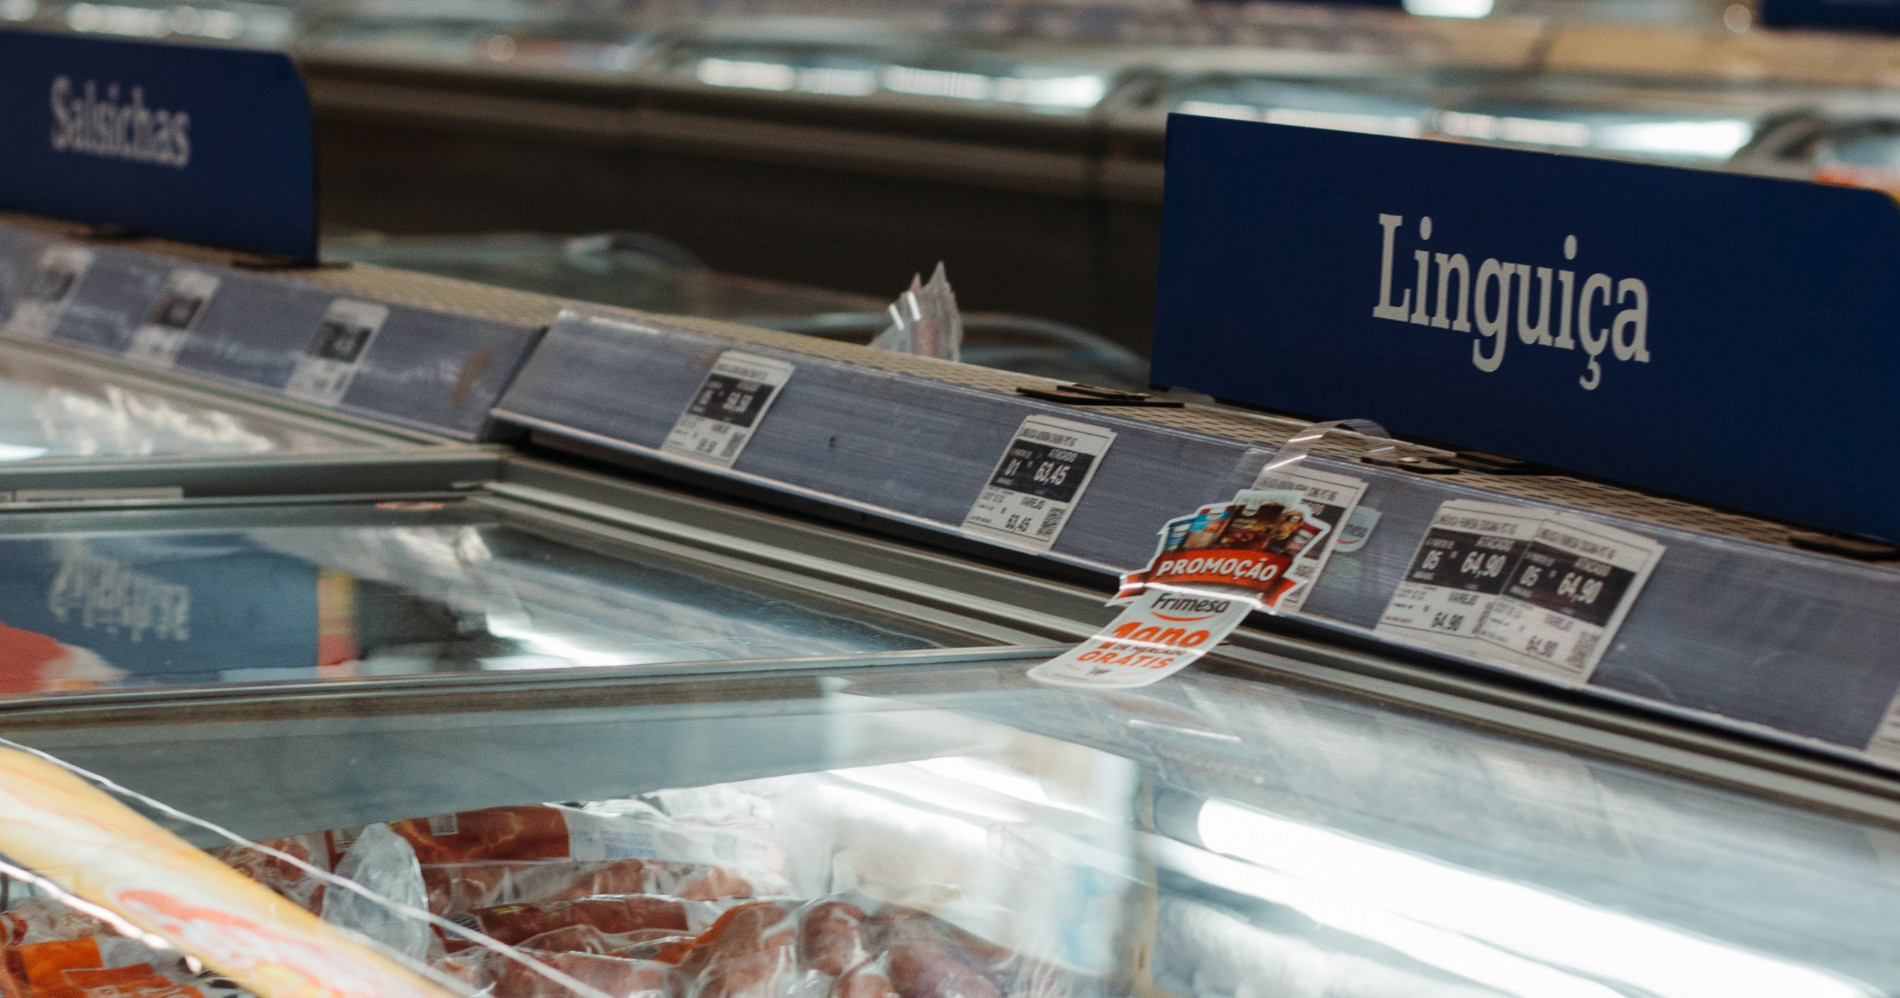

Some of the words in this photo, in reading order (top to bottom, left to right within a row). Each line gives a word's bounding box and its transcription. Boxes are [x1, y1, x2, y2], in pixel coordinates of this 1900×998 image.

[1372, 213, 1650, 390] Linguiça
[1033, 460, 1071, 486] 63,45
[1156, 557, 1278, 581] PROMOÇÃO
[1460, 550, 1507, 579] 64,90
[1557, 572, 1604, 605] 64,90
[1151, 592, 1230, 613] Frimesa
[1077, 650, 1175, 669] GRÁTIS
